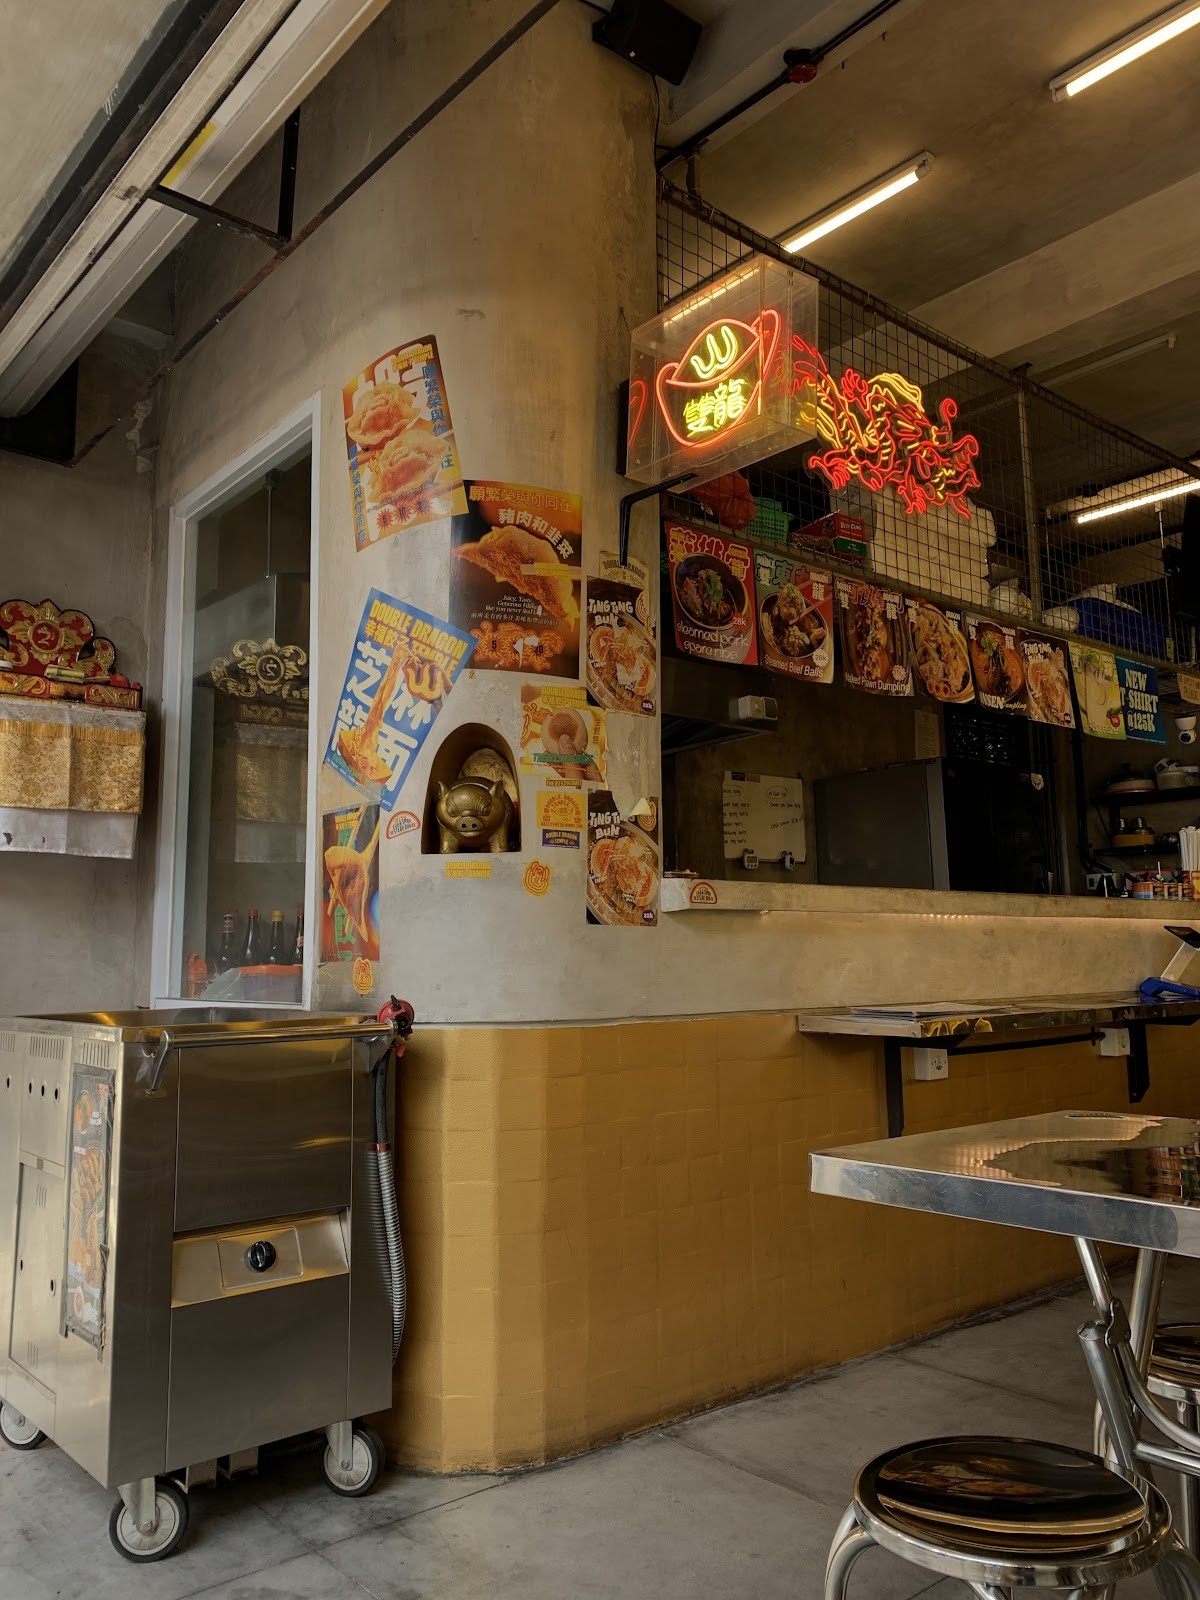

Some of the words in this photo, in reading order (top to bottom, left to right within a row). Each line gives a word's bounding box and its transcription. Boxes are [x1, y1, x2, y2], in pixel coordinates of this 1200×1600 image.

[469, 485, 573, 513] 願繁榮與你同在
[498, 508, 574, 559] 豬肉和韭菜
[370, 599, 413, 634] DOUBLE
[410, 618, 468, 661] DRAGON
[732, 617, 747, 627] 28k
[491, 640, 497, 651] 5
[683, 640, 713, 655] spare
[719, 631, 749, 648] pork
[534, 644, 544, 655] 30
[764, 653, 789, 672] Steamed
[788, 662, 804, 675] Beef
[804, 665, 824, 677] Balls
[878, 680, 911, 696] Dumpling
[1125, 668, 1147, 692] NEW
[1120, 687, 1159, 714] T-SHIRT
[596, 823, 620, 840] BUN
